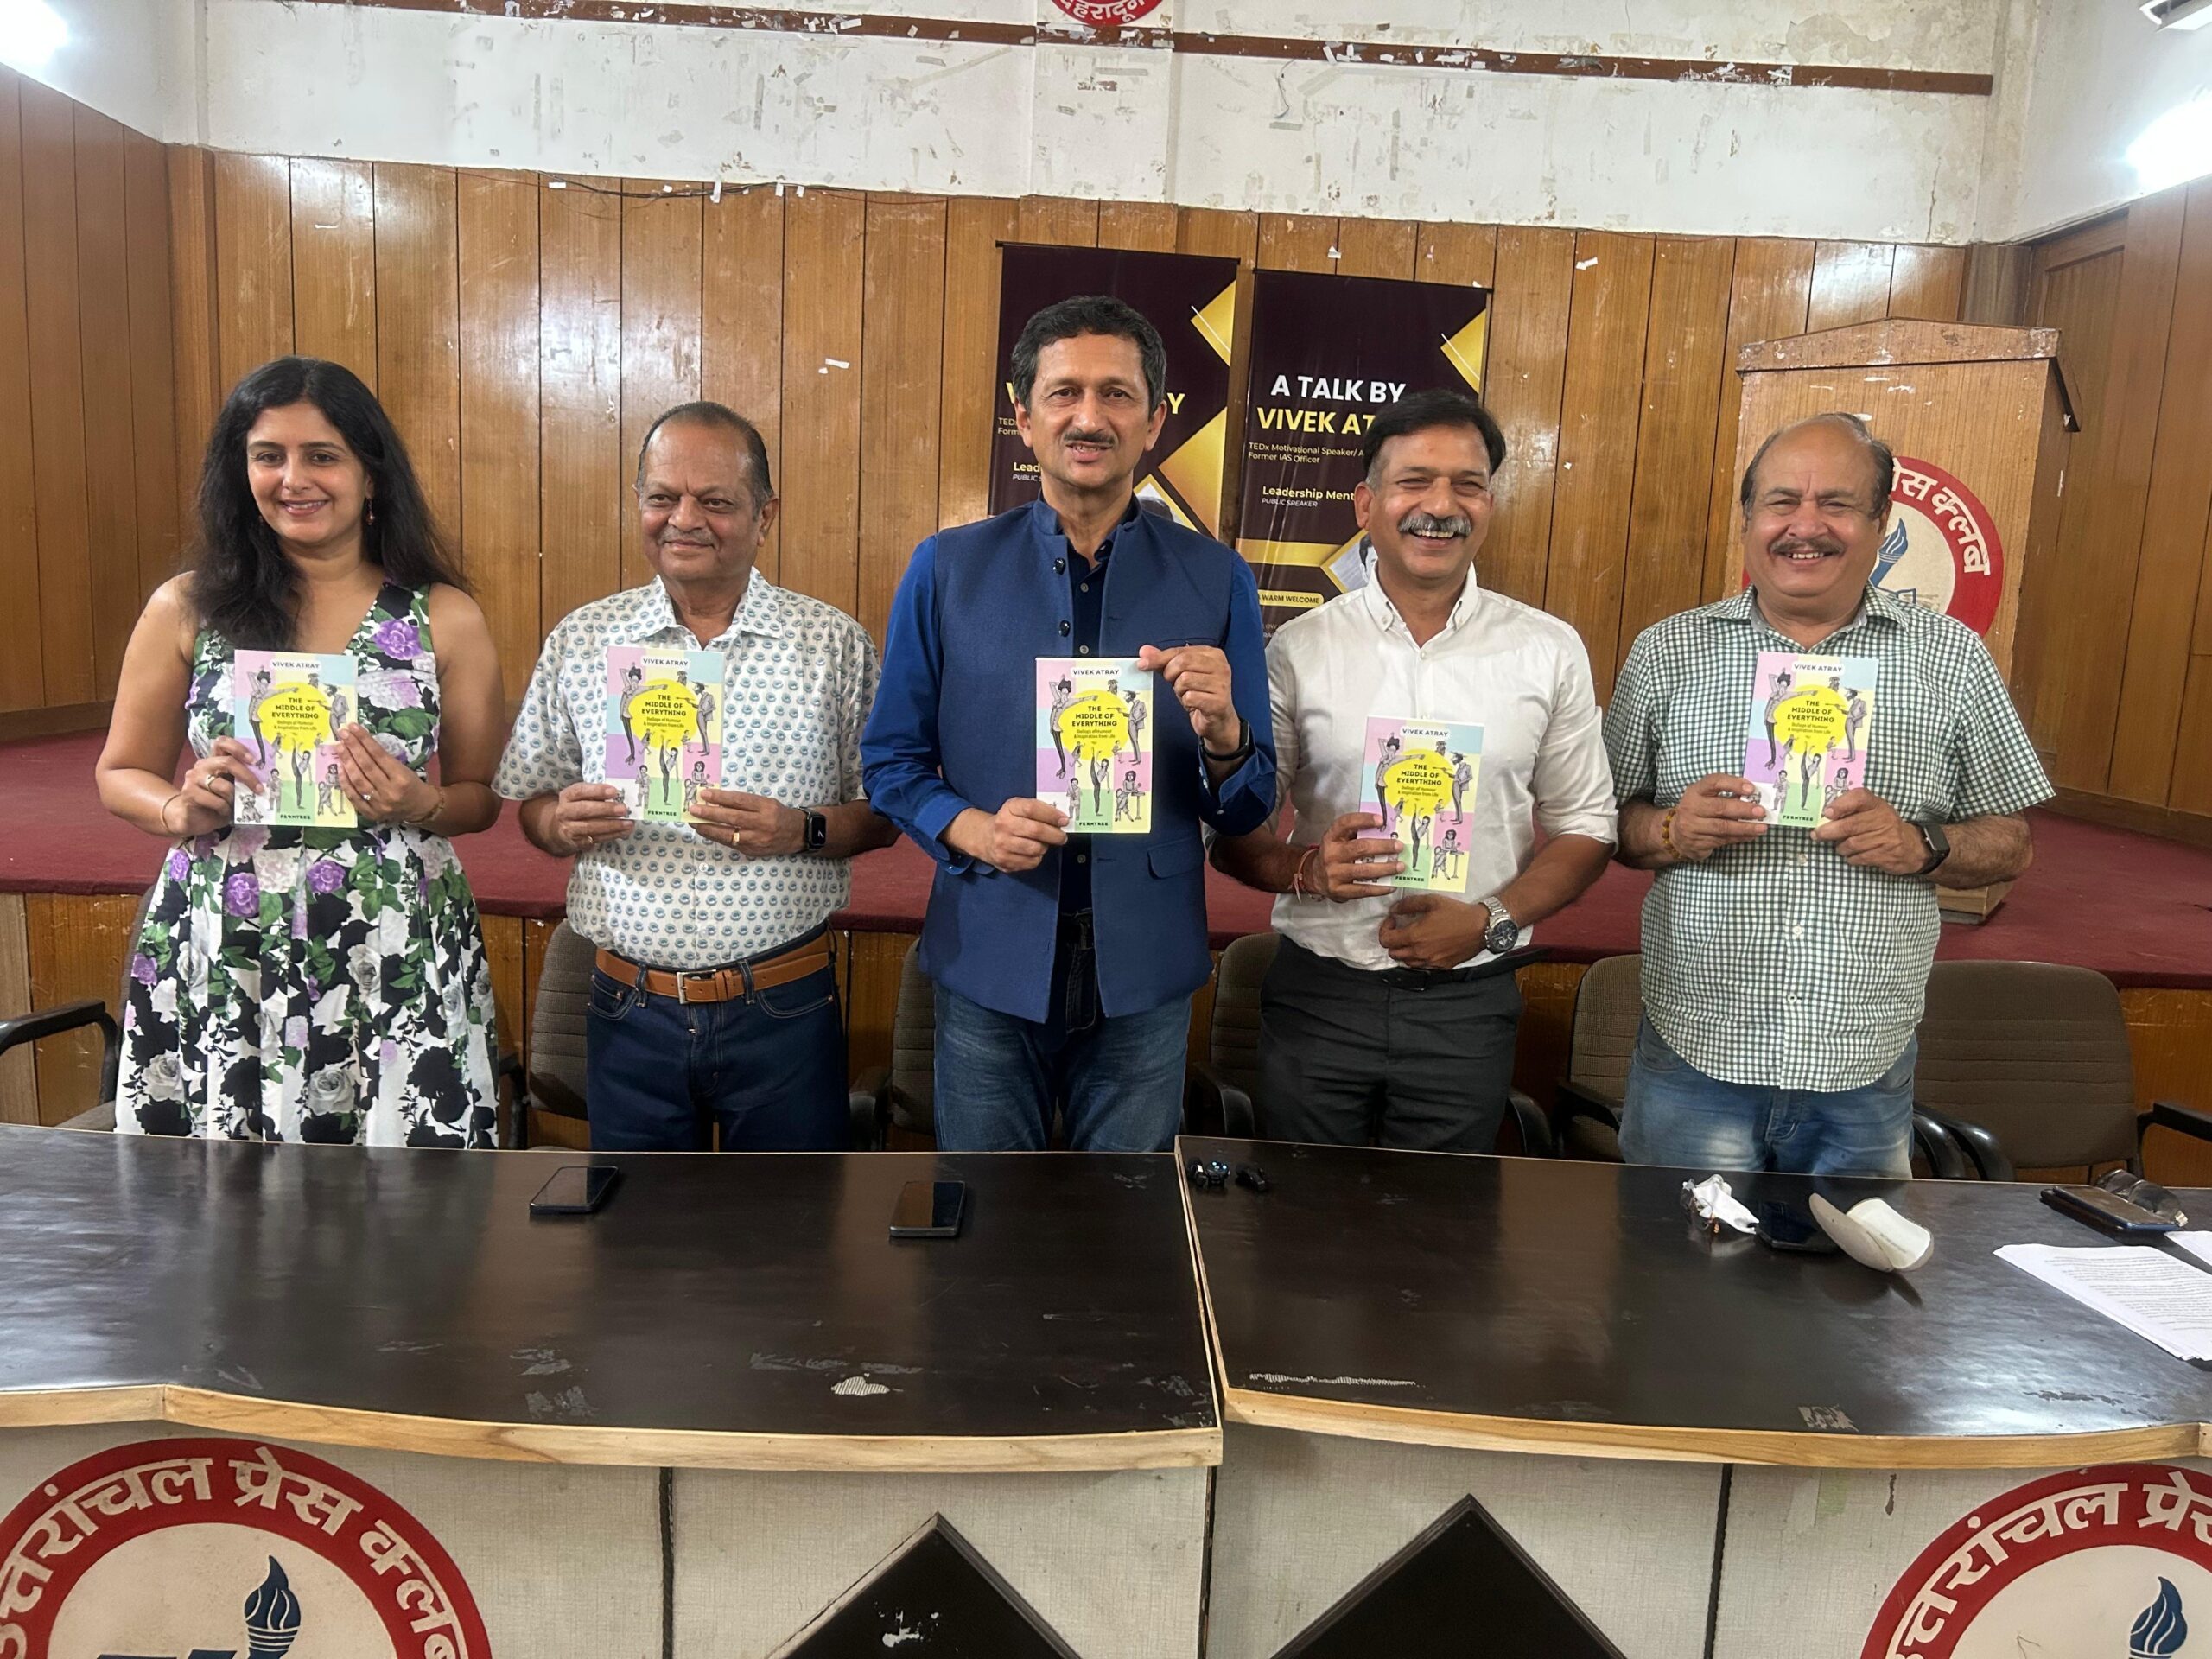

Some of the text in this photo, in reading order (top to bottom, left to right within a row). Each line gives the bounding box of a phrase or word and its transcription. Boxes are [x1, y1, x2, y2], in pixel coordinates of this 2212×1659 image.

[1270, 374, 1407, 404] A TALK BY
[998, 416, 1017, 426] TED
[1256, 406, 1336, 434] VIVEK
[1249, 442, 1269, 451] TEDx
[1271, 443, 1319, 454] Motivational
[1248, 451, 1320, 463] Former IAS Officer
[1262, 486, 1324, 500] Leadership
[1286, 595, 1319, 604] WELCOME
[1787, 714, 1834, 722] EVERYTHING
[228, 1446, 364, 1536] प्रेस
[1885, 1482, 2128, 1659] त्तरांचल
